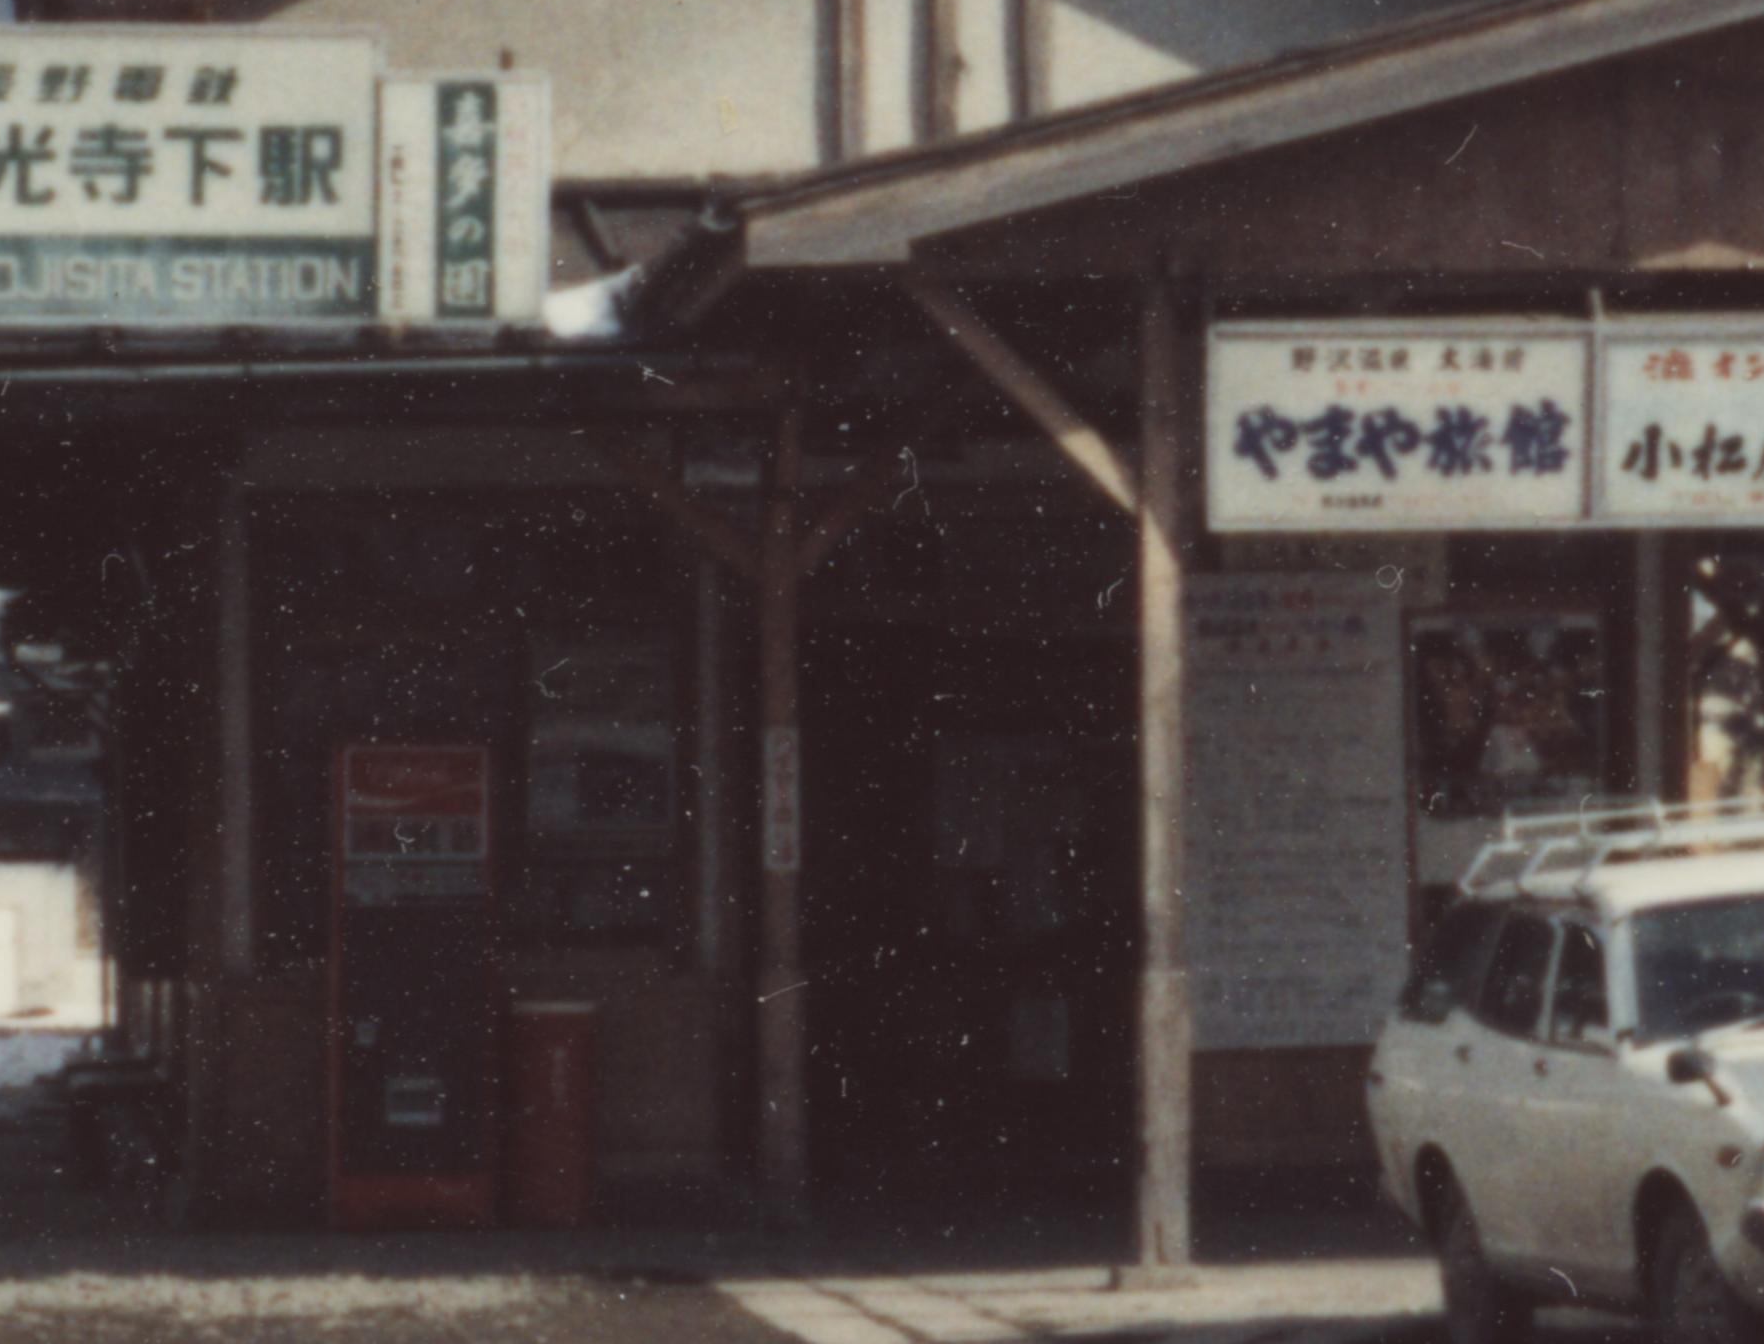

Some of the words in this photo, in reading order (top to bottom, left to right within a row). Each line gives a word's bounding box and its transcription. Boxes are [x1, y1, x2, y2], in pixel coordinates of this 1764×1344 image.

[171, 254, 360, 301] STATION
[1233, 397, 1571, 481] やまや旅館
